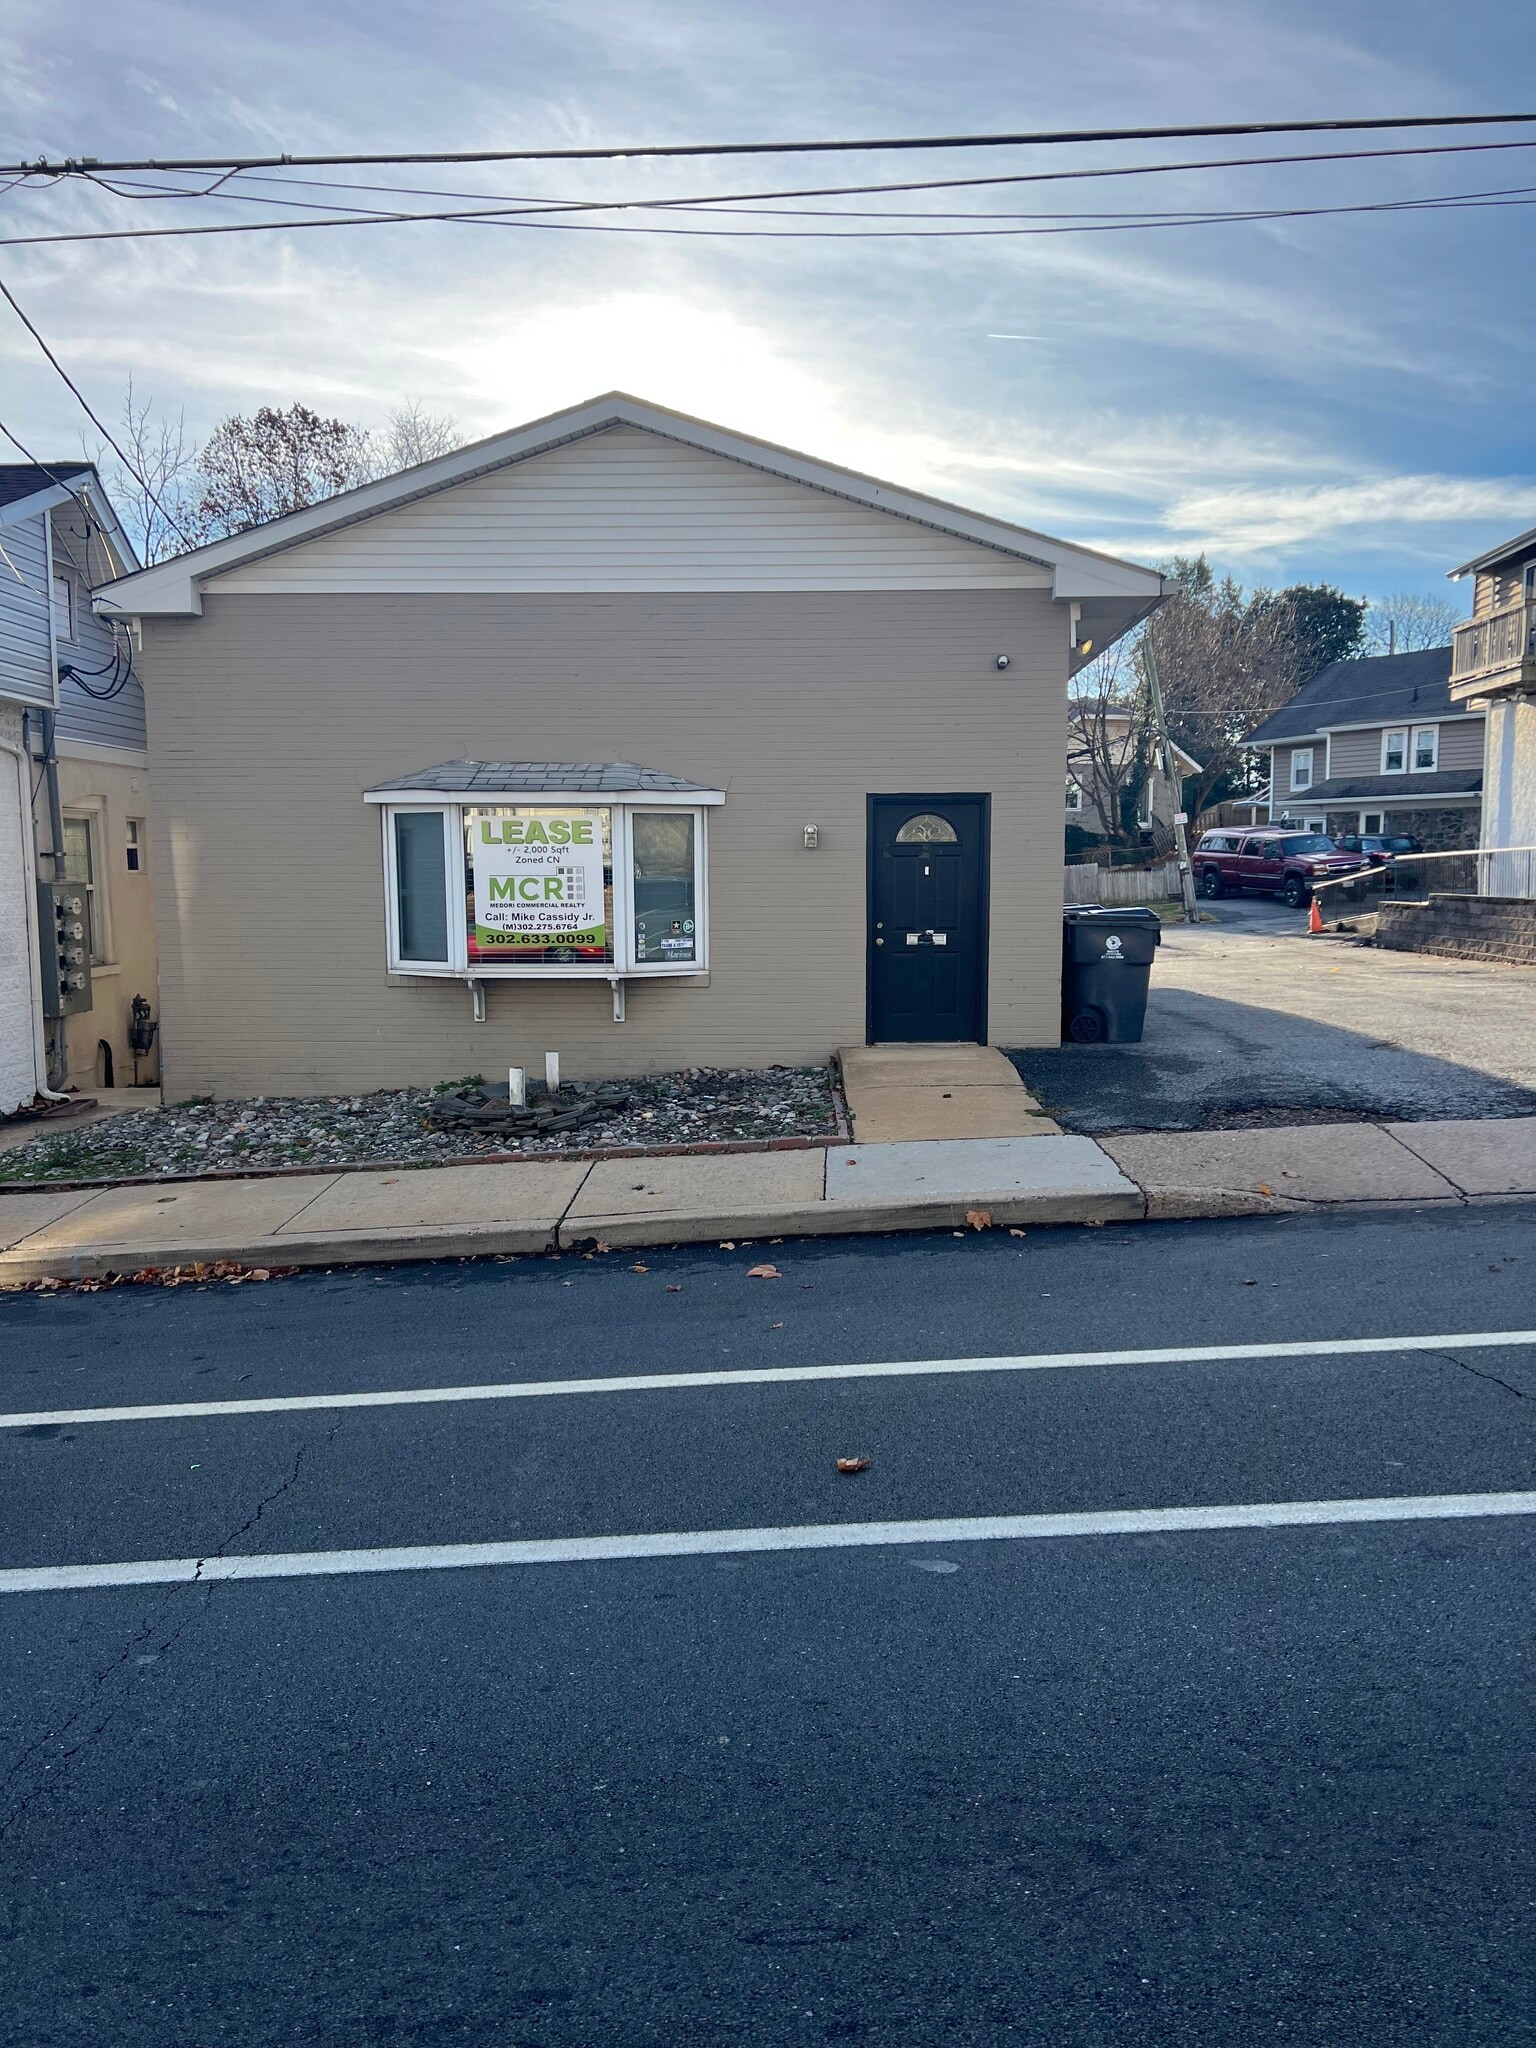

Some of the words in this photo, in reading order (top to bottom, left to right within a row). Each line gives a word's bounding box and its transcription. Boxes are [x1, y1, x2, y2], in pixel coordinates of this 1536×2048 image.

[481, 820, 593, 844] LEASE
[524, 846, 547, 854] 2,000
[551, 846, 569, 855] Sqft
[490, 877, 564, 901] MCR
[485, 913, 508, 921] Call:
[511, 913, 535, 921] Mike
[538, 913, 580, 922] Cassidy
[583, 913, 595, 921] Jr.
[486, 934, 595, 944] 302.633.0099
